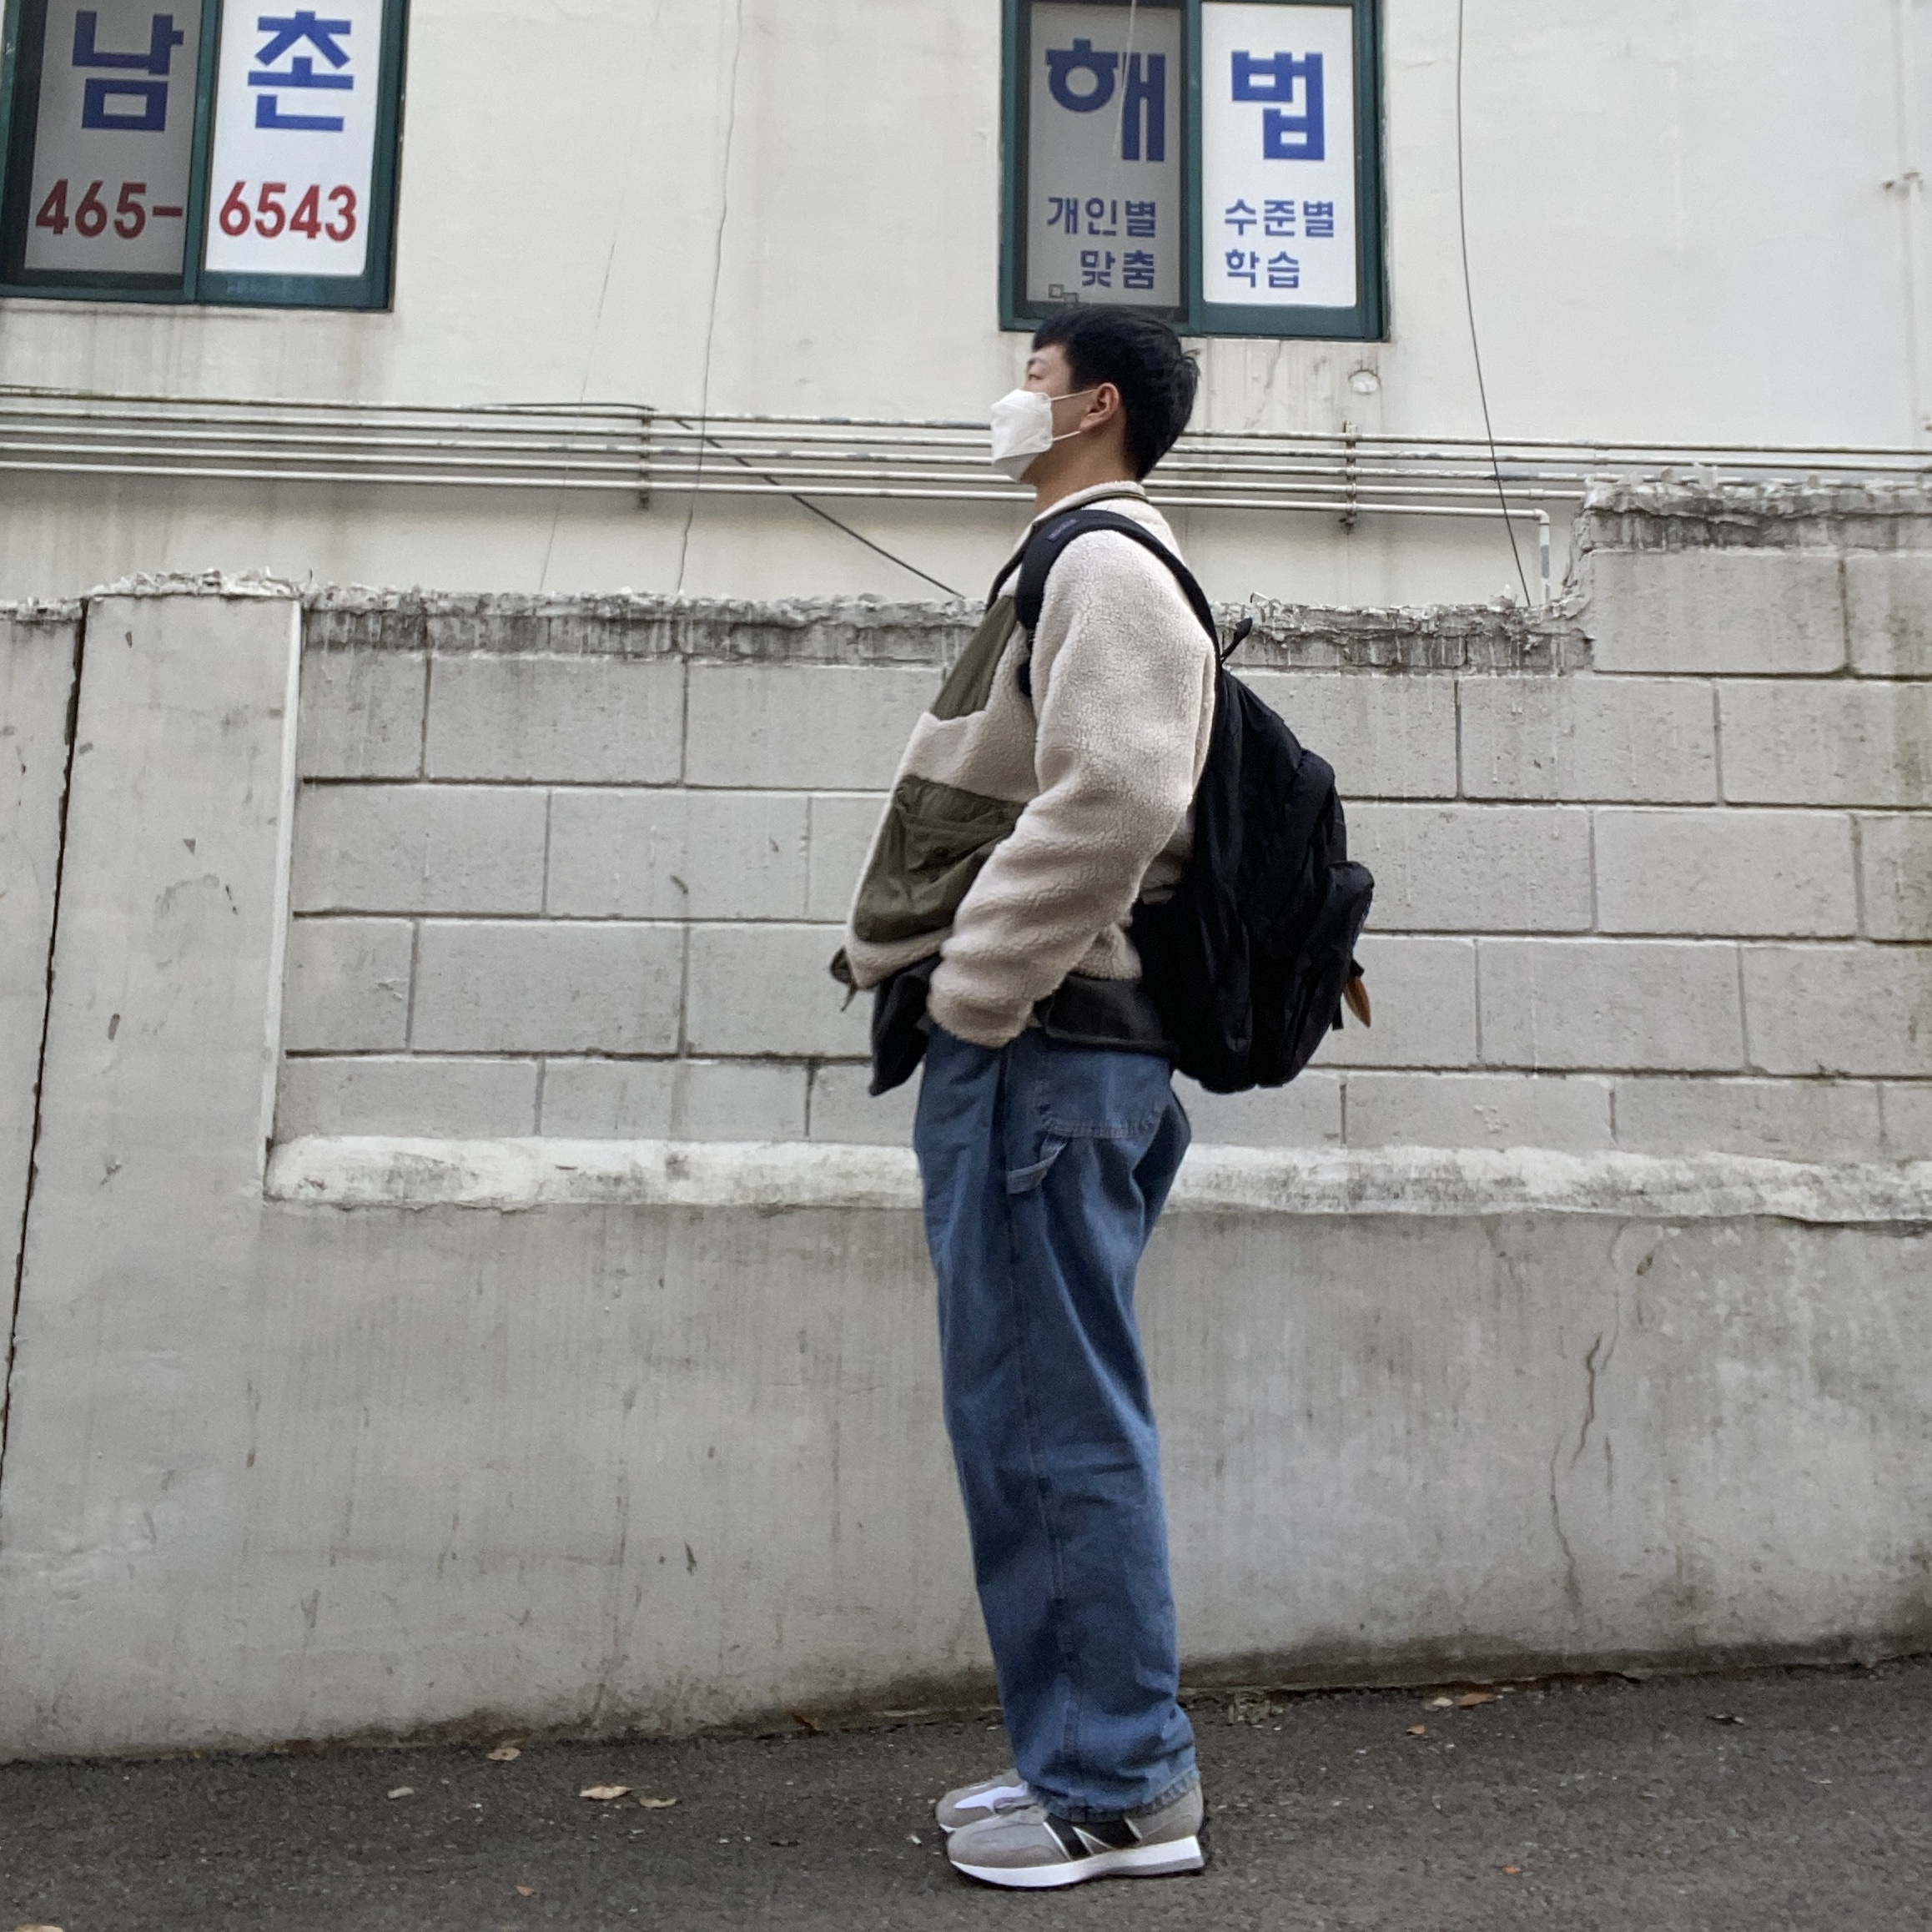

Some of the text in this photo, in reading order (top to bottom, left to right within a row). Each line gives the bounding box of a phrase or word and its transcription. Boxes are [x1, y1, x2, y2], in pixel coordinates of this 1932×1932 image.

[1046, 196, 1156, 239] 개인별
[1224, 199, 1335, 239] 수준별
[1079, 249, 1155, 290] 맞춤
[1224, 249, 1301, 290] 학습
